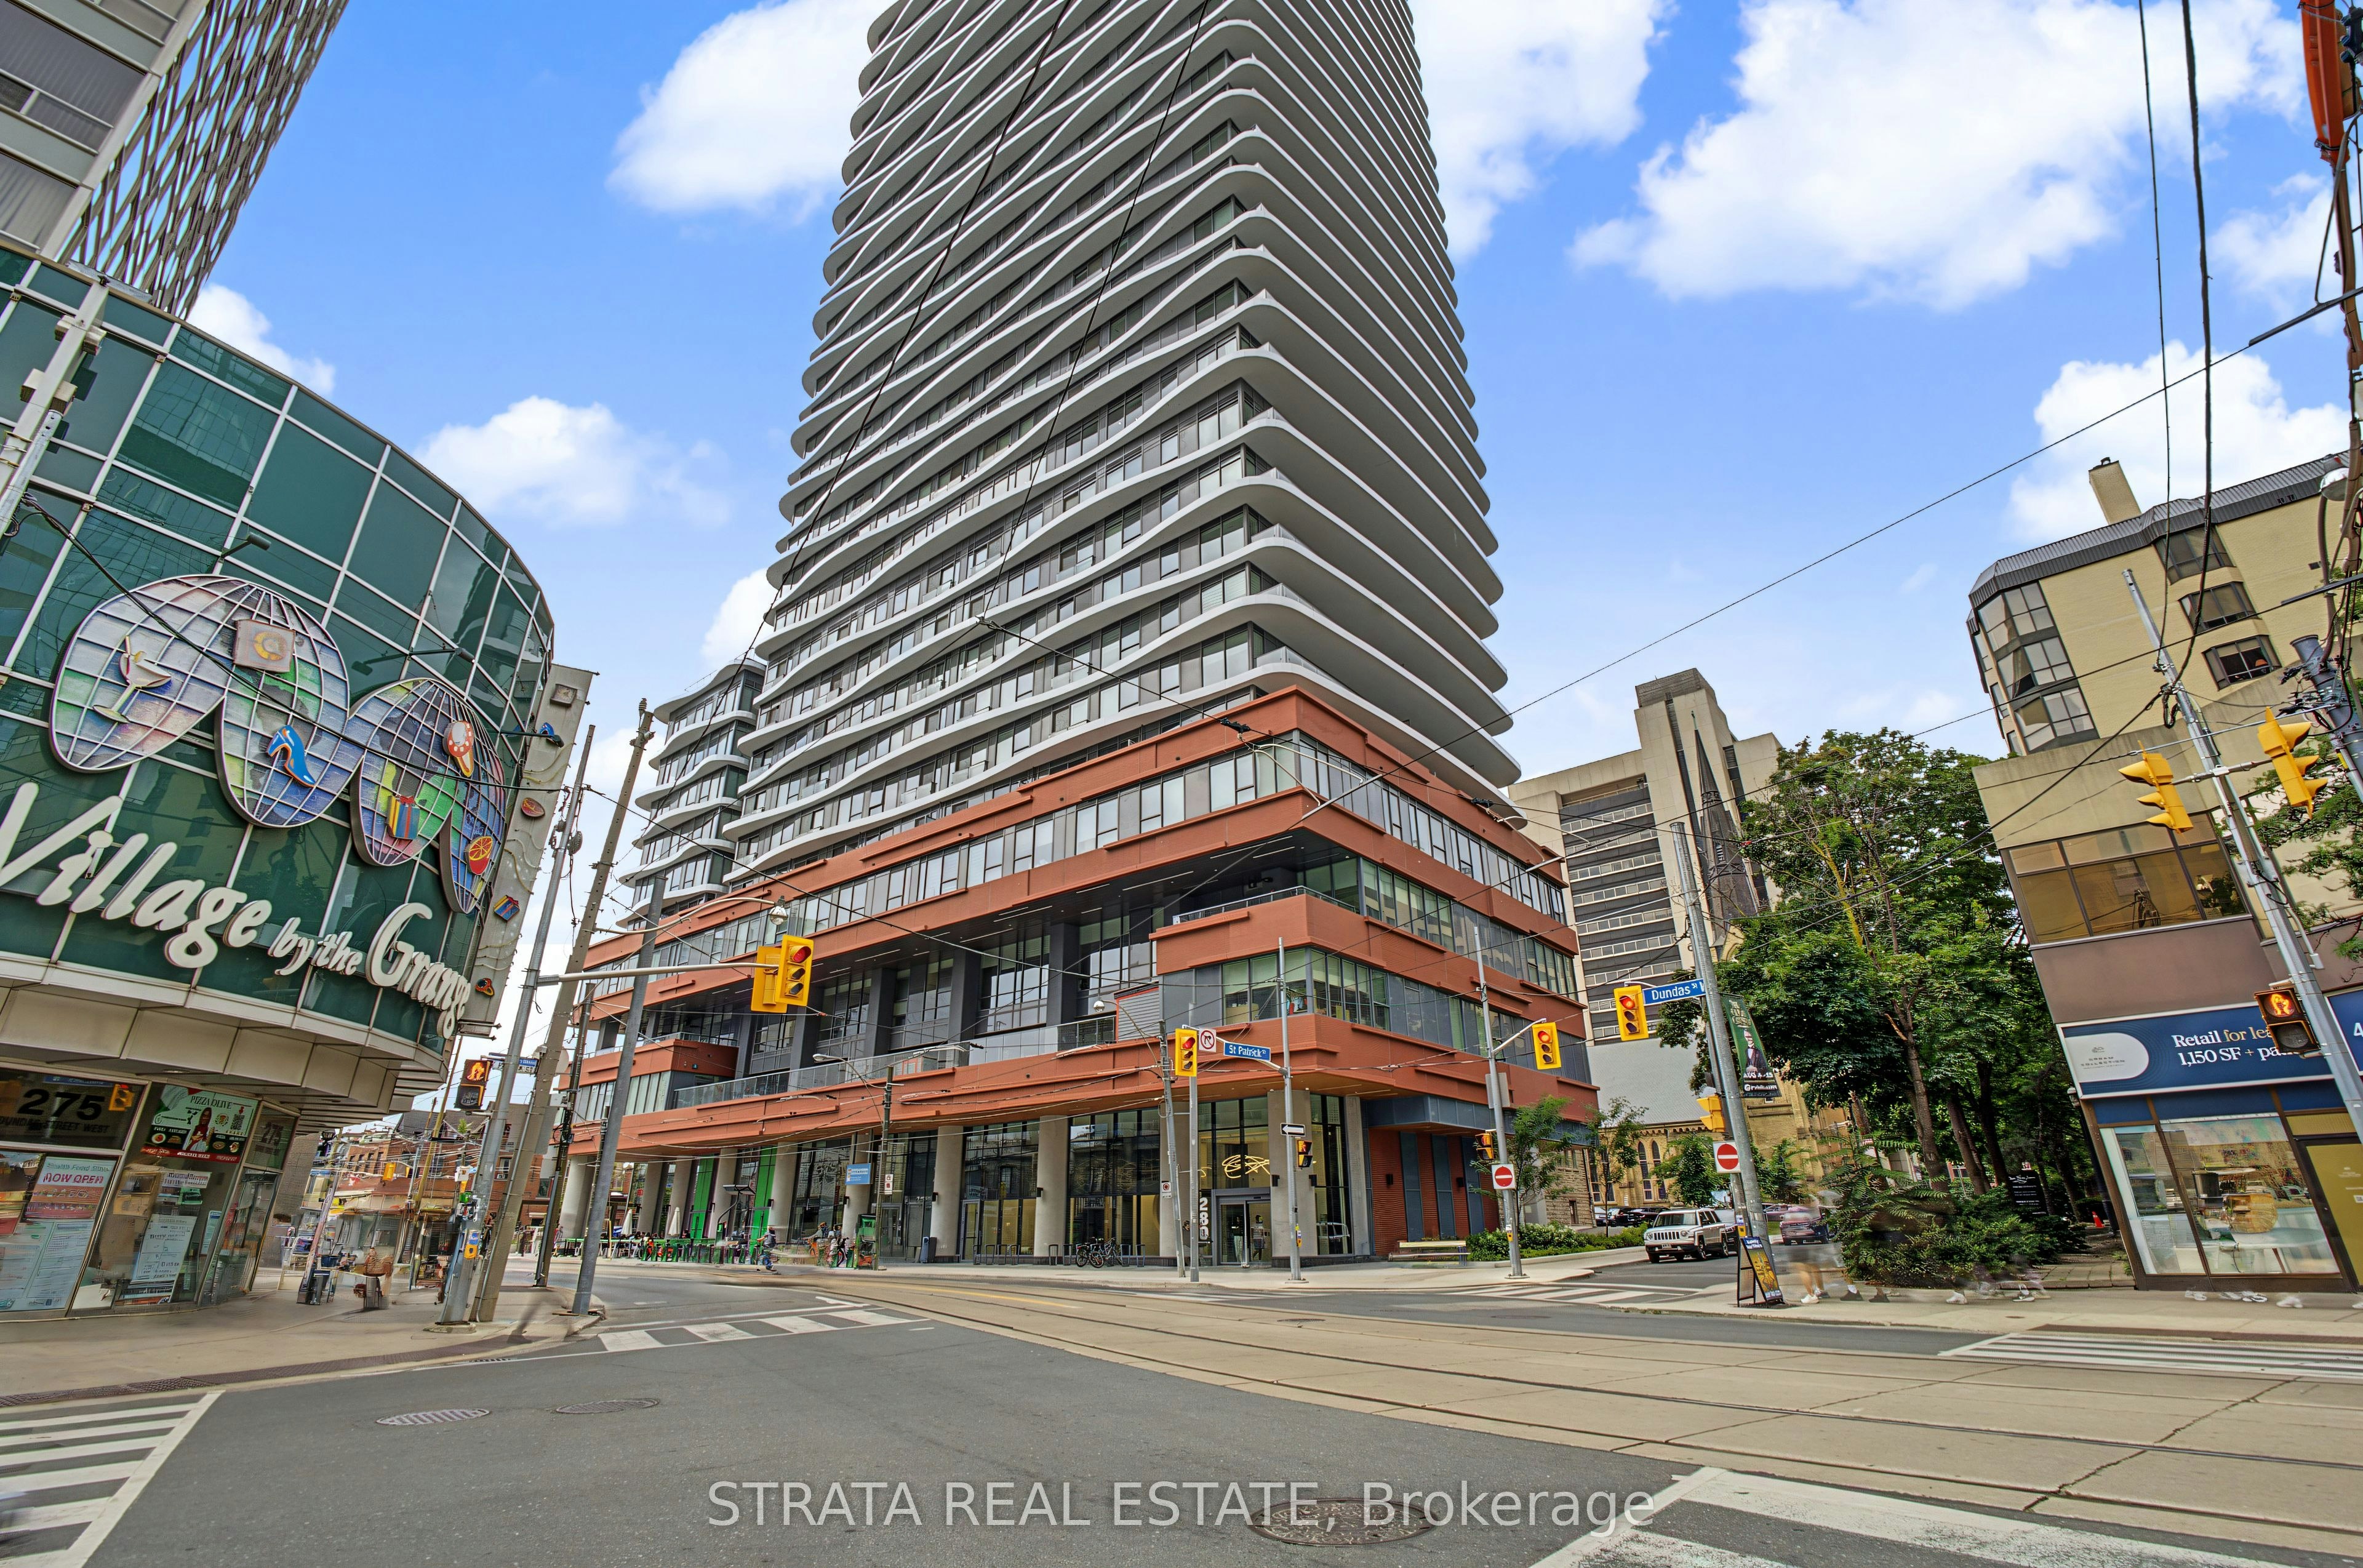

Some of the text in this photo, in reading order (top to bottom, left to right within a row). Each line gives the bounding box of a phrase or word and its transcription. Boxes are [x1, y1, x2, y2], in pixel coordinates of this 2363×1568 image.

[0, 782, 471, 1039] Village by the Grange
[1652, 986, 1690, 1000] Dundas
[2171, 1030, 2222, 1047] Retail
[2223, 1029, 2247, 1042] for
[1229, 1045, 1236, 1054] St
[1238, 1046, 1262, 1057] Patrick
[2178, 1049, 2217, 1067] 1,150
[2219, 1047, 2241, 1062] SF
[17, 1089, 105, 1121] 275
[84, 1122, 111, 1133] WEST
[73, 1174, 104, 1184] OPEN
